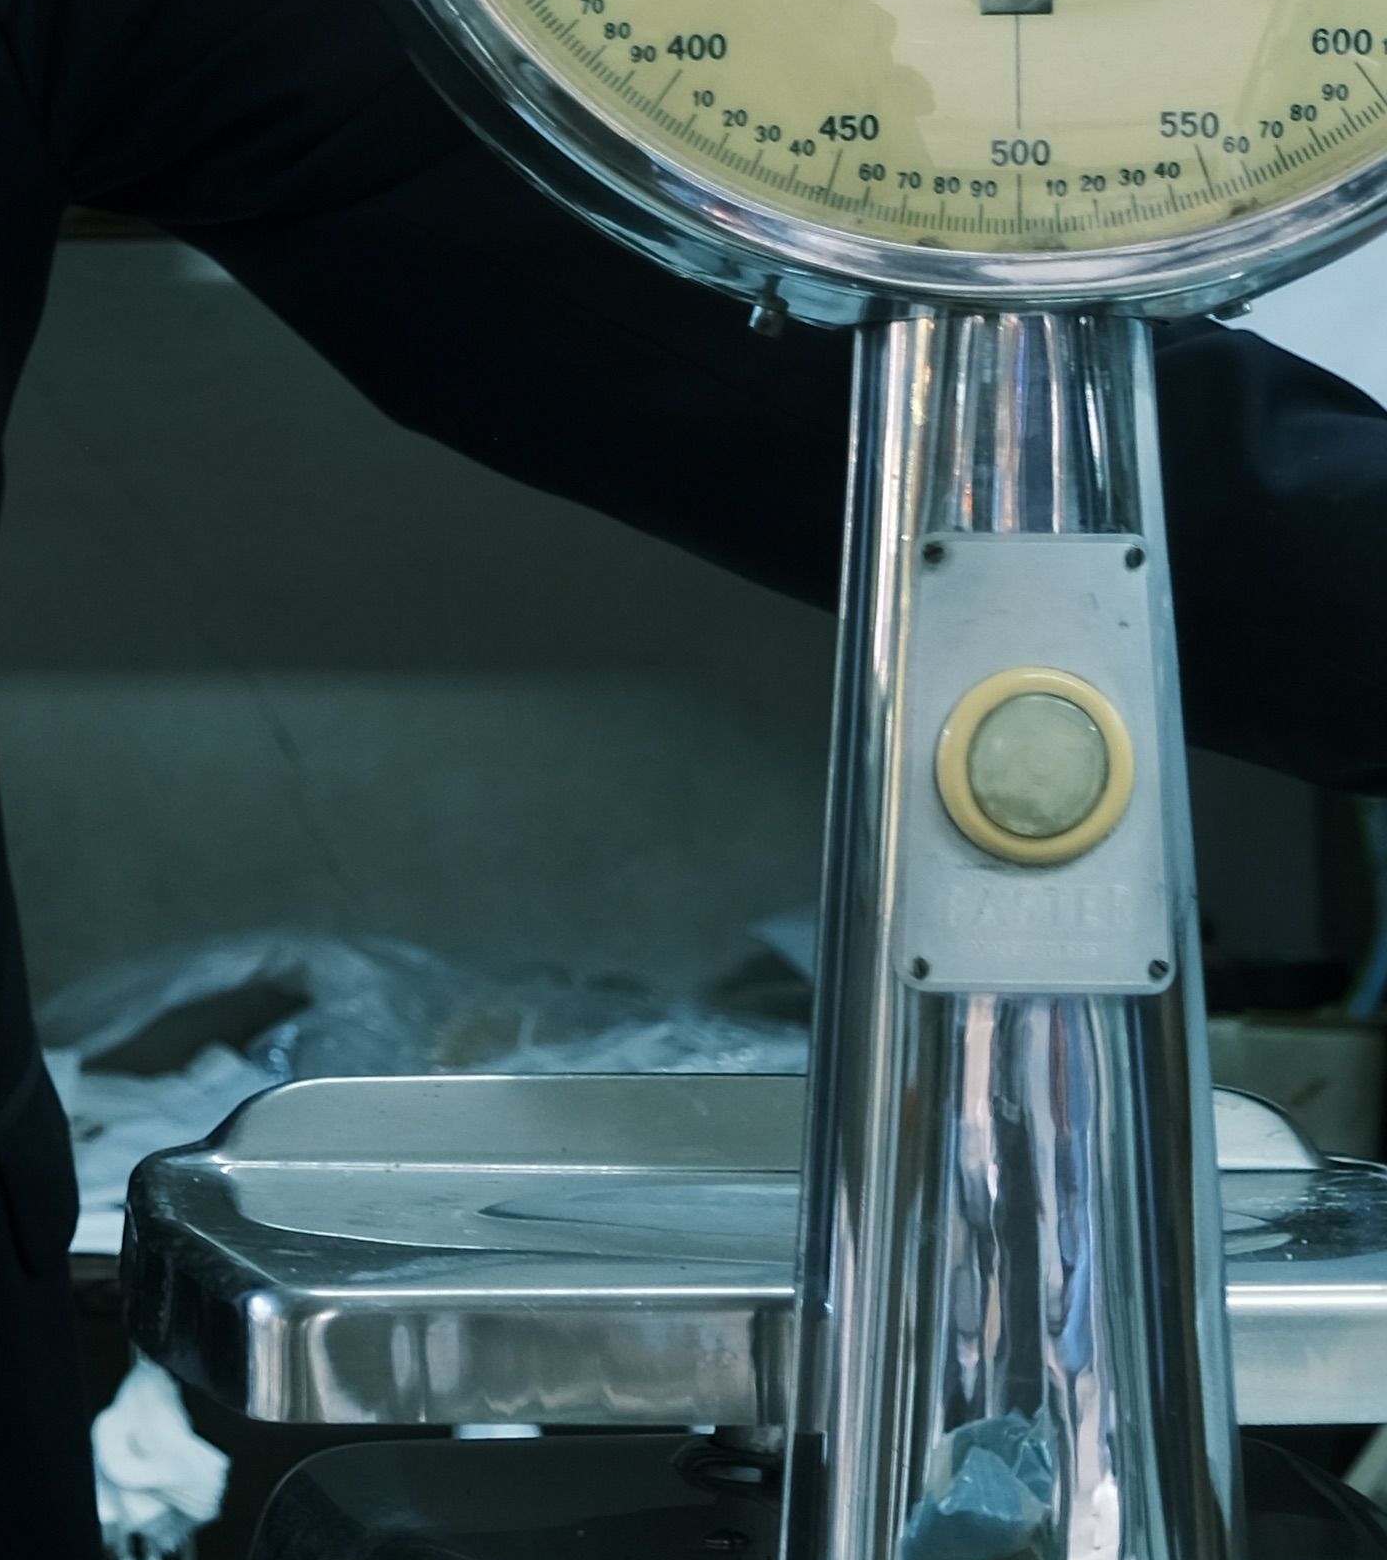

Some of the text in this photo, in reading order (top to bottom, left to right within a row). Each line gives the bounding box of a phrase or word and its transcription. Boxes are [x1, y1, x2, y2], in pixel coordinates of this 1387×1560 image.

[604, 23, 631, 40] 80
[667, 33, 727, 60] 400
[1311, 28, 1372, 55] 600
[630, 45, 657, 63] 90
[693, 90, 714, 107] 10
[1322, 83, 1349, 101] 90
[722, 109, 748, 127] 20
[1290, 104, 1317, 121] 80
[755, 125, 781, 142] 30
[819, 115, 879, 141] 450
[1160, 111, 1220, 138] 550
[1258, 120, 1284, 138] 70
[789, 139, 816, 157] 40
[991, 140, 1051, 166] 500
[1223, 136, 1250, 153] 60
[859, 163, 886, 181] 60
[1118, 169, 1146, 186] 30
[1154, 162, 1181, 178] 40
[898, 171, 922, 189] 70
[933, 176, 960, 194] 80
[970, 180, 997, 197] 90
[1046, 180, 1067, 196] 10
[1080, 175, 1106, 192] 20
